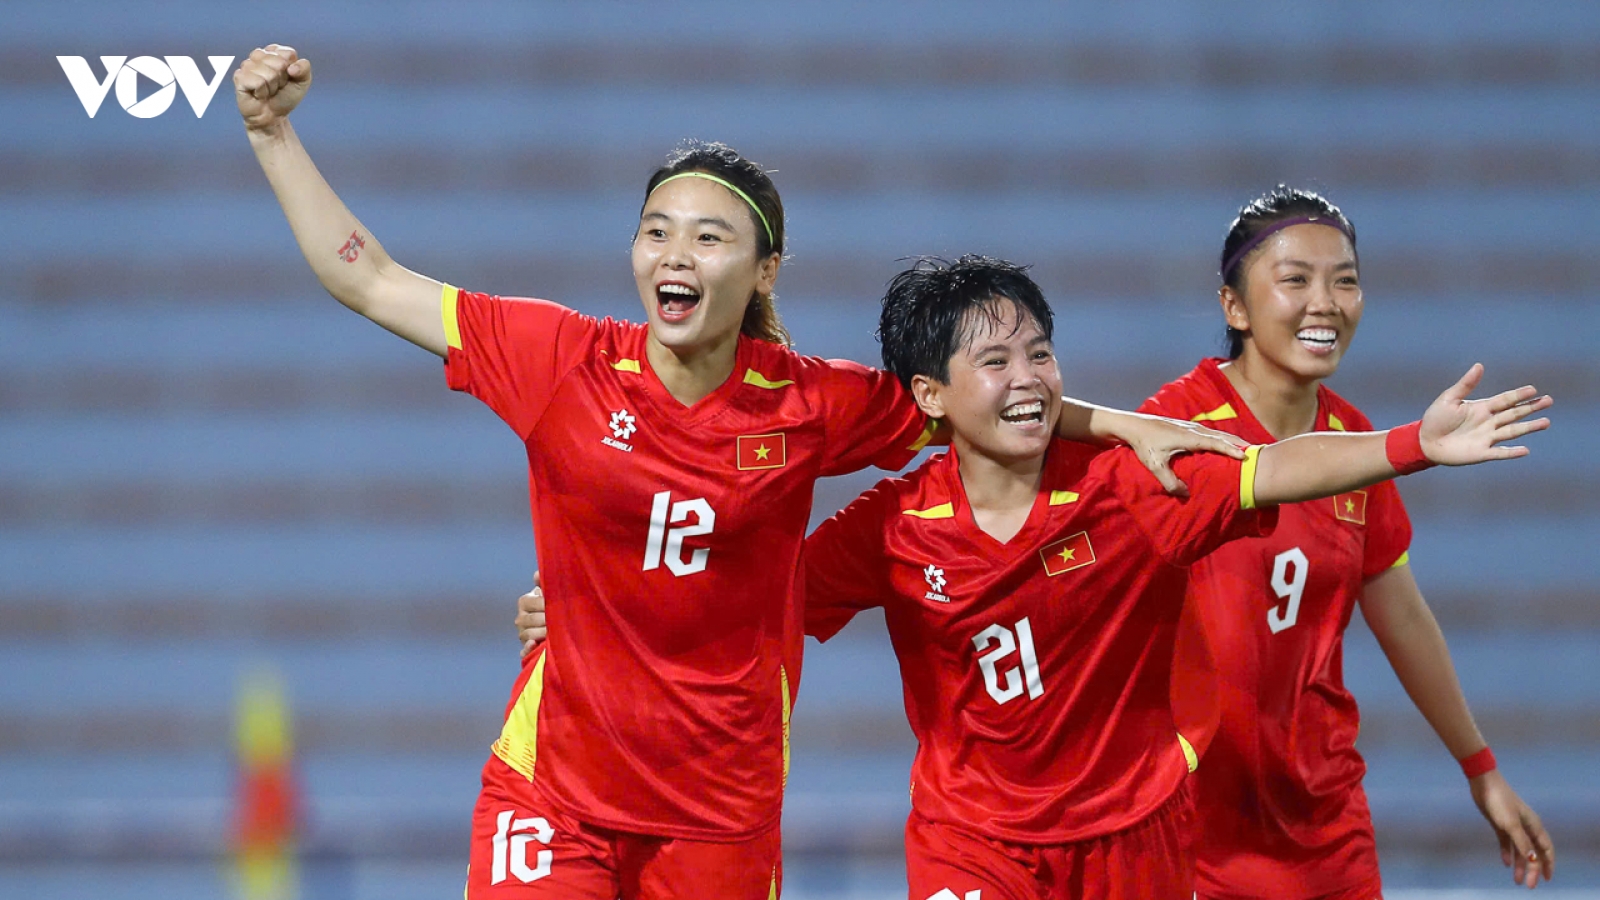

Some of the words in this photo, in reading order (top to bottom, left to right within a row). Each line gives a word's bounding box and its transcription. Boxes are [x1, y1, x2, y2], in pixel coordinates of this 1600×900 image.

[643, 491, 715, 576] 12
[1267, 547, 1308, 634] 9
[973, 617, 1044, 704] 21
[491, 810, 555, 885] 12
